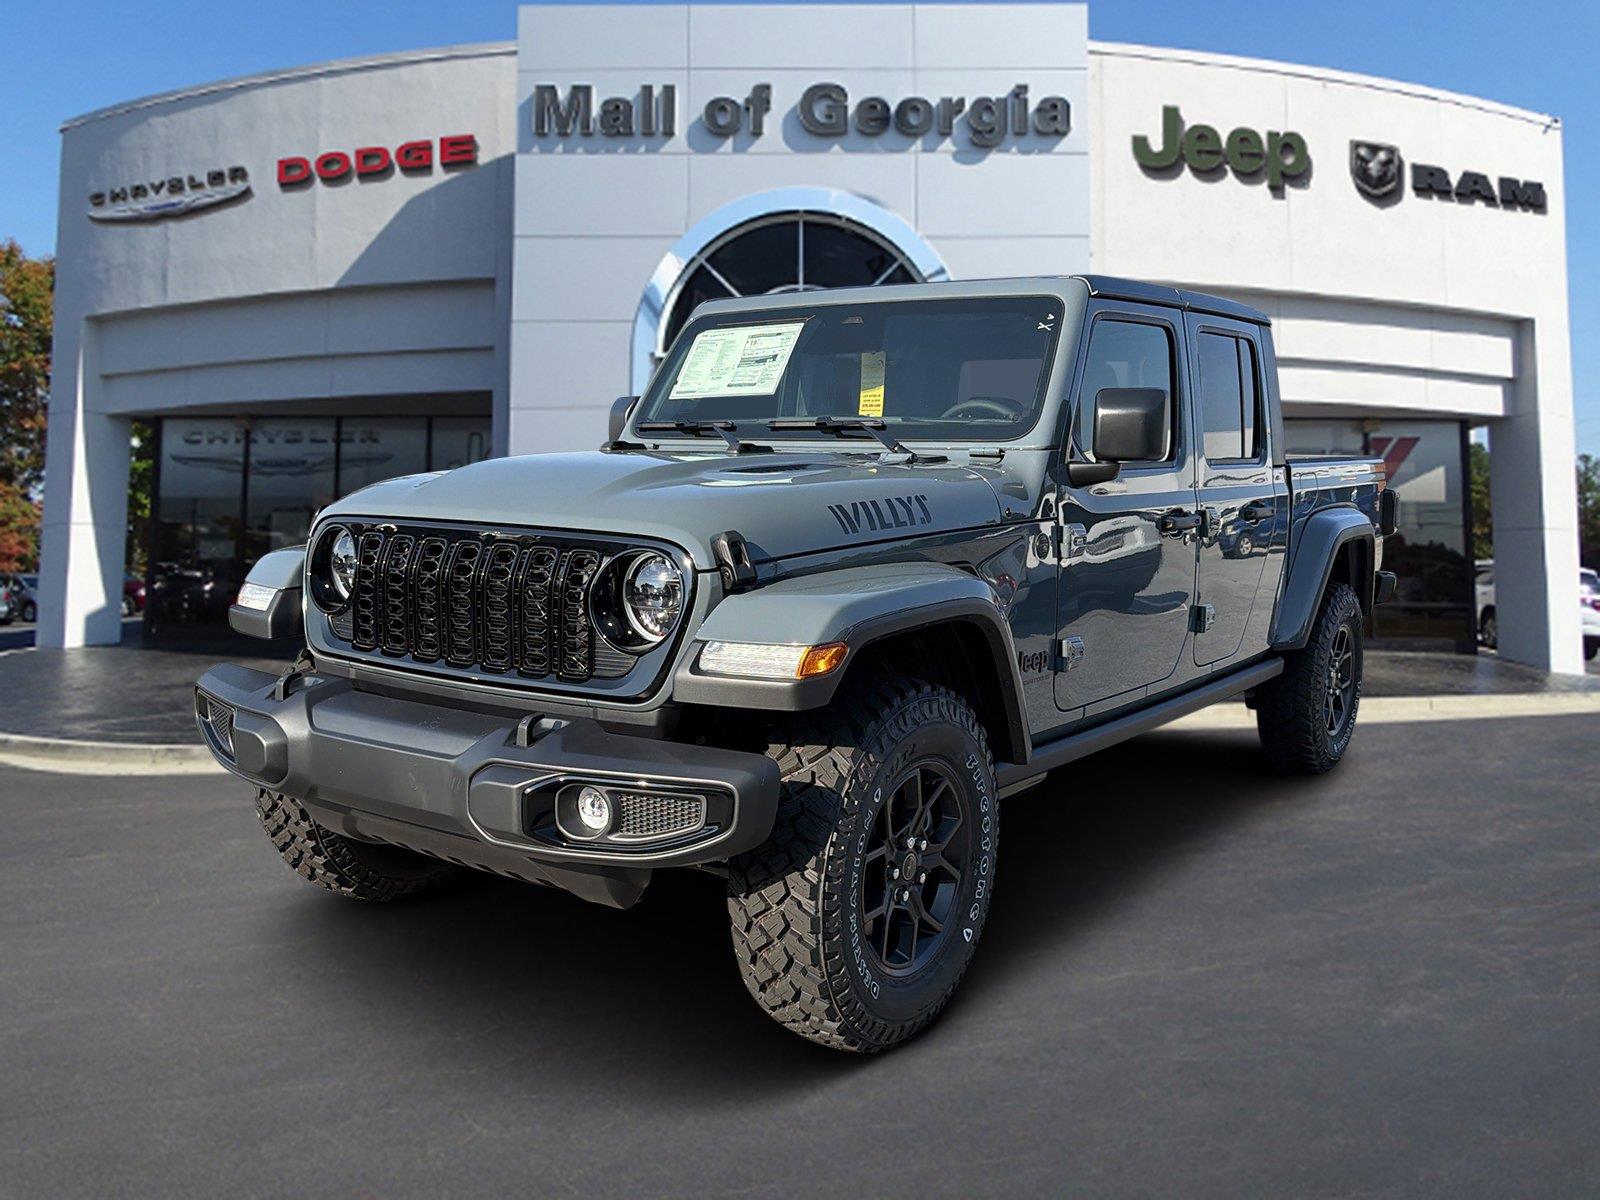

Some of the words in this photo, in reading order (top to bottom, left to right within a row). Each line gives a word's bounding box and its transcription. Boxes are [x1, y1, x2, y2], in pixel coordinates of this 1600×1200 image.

[532, 84, 676, 137] Mall
[704, 84, 772, 137] of
[799, 84, 1072, 147] Georgia
[277, 134, 475, 185] DODGE
[1132, 105, 1309, 188] Jeep
[88, 166, 249, 207] CHRYSLER
[1411, 163, 1547, 213] RAM
[828, 495, 932, 534] WILLYS
